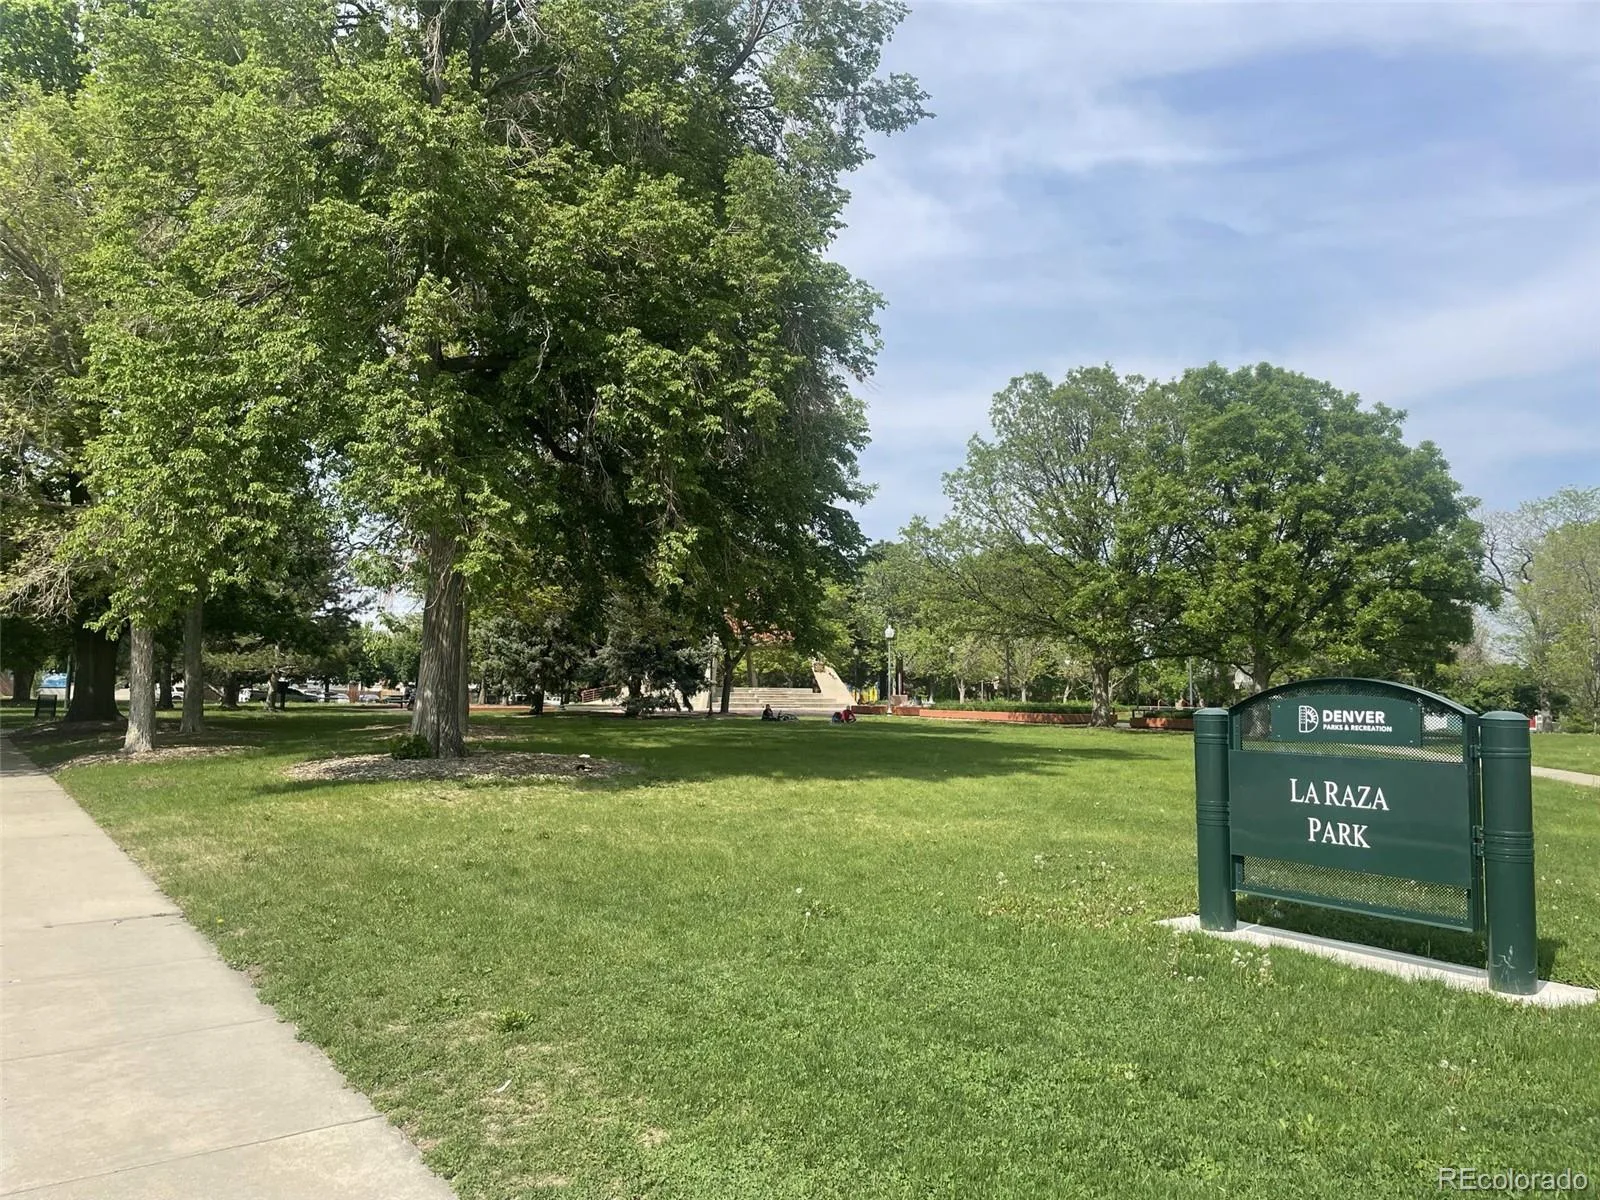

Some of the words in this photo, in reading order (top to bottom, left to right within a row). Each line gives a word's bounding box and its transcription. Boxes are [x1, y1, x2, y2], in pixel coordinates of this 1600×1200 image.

[1322, 709, 1385, 724] DENVER
[1322, 723, 1343, 731] PARKS
[1351, 724, 1393, 732] RECREATION
[1289, 778, 1320, 805] LA
[1323, 780, 1390, 811] RAZA
[1307, 817, 1371, 849] PARK
